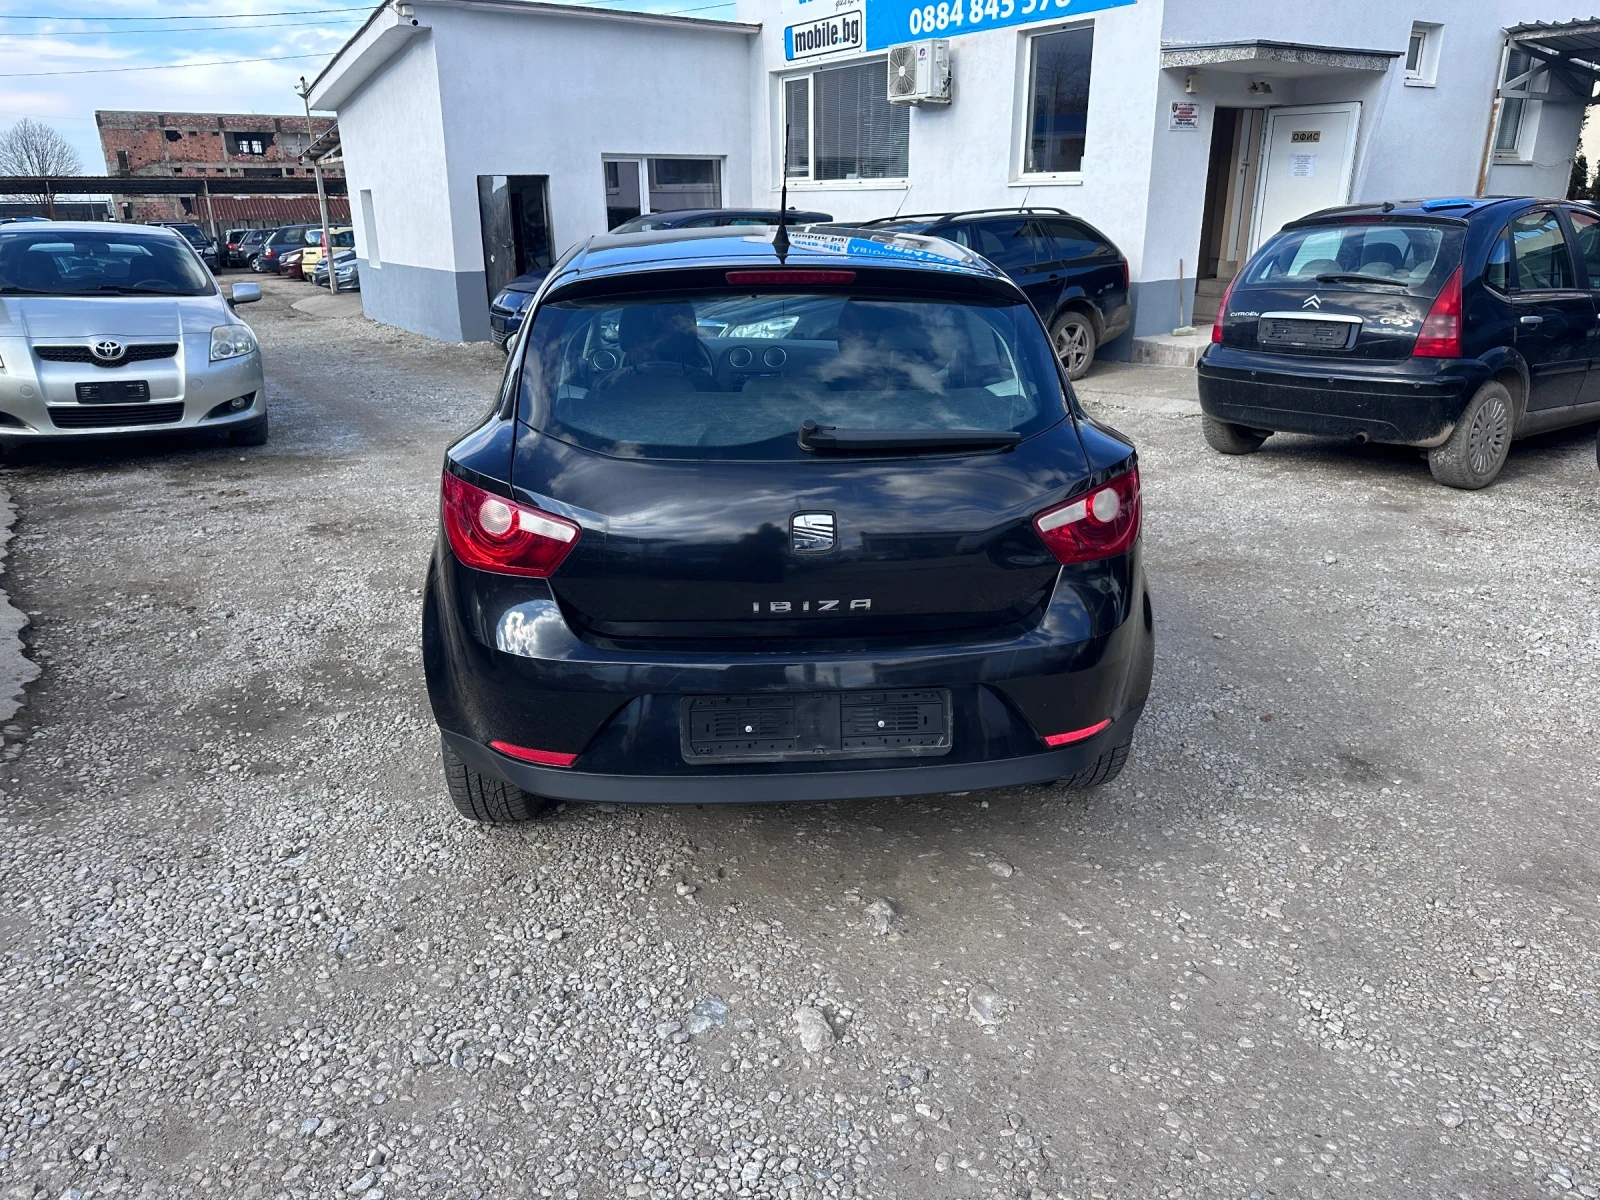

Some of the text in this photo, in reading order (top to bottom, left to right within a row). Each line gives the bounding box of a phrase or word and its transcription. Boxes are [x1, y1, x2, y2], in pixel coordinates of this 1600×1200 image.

[909, 0, 964, 35] 0884
[794, 17, 859, 52] mobile.bg
[1292, 132, 1319, 141] ОФИС
[752, 598, 871, 613] IBIZA
